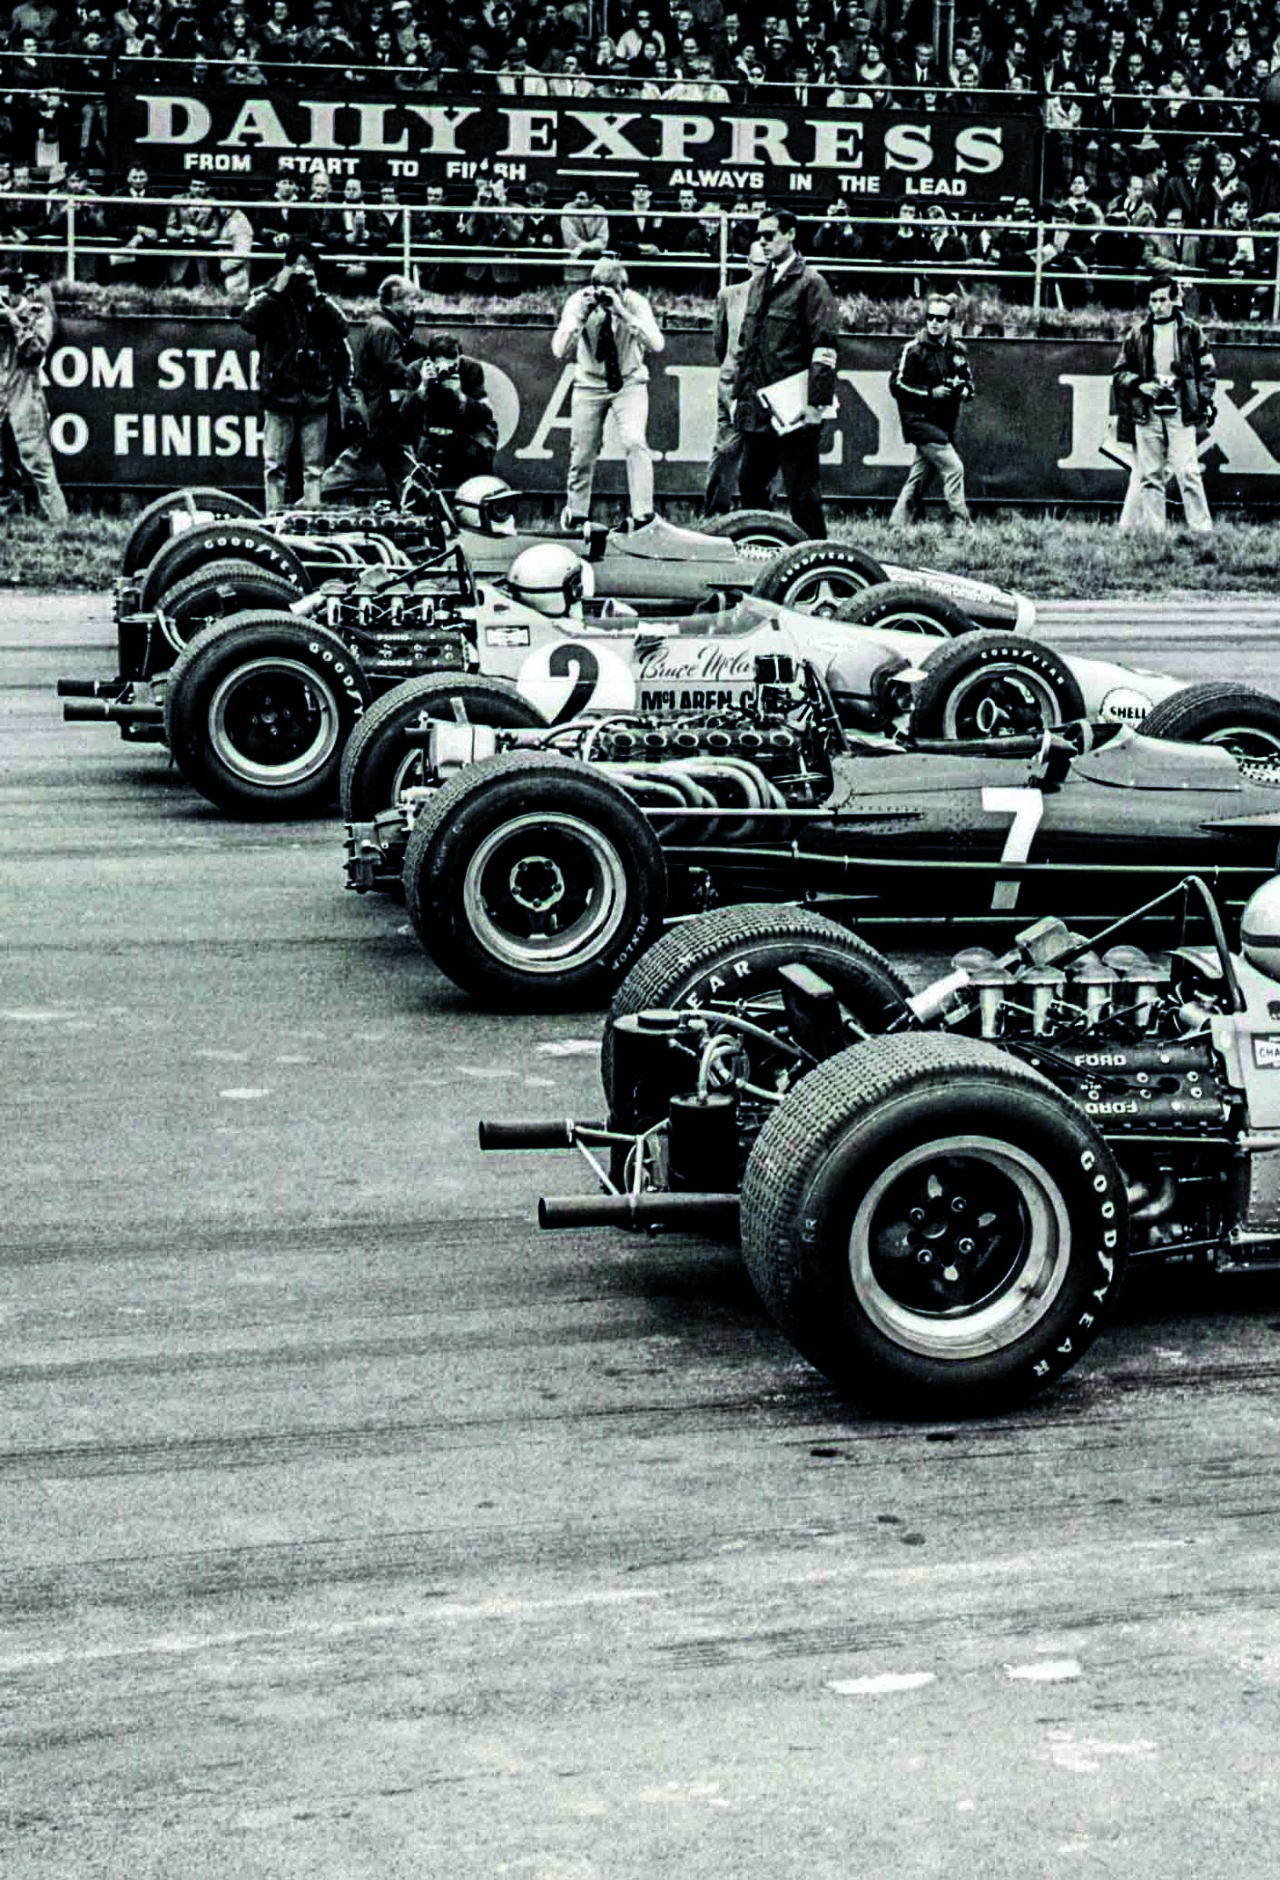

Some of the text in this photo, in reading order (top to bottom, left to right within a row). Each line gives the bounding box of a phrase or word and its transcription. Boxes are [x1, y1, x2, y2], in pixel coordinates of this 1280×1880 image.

[136, 95, 1003, 173] DAILY EXPRESS
[184, 152, 526, 181] FROM START TO FISH
[669, 170, 967, 196] ALWAYS IN THE LEAD
[39, 346, 134, 389] OM
[549, 643, 598, 728] 2
[981, 648, 1065, 685] GOODYEAR
[1110, 706, 1147, 719] SHELL
[981, 787, 1043, 909] 7
[1074, 1054, 1126, 1066] FORD
[1033, 1150, 1118, 1378] GOODYEAR
